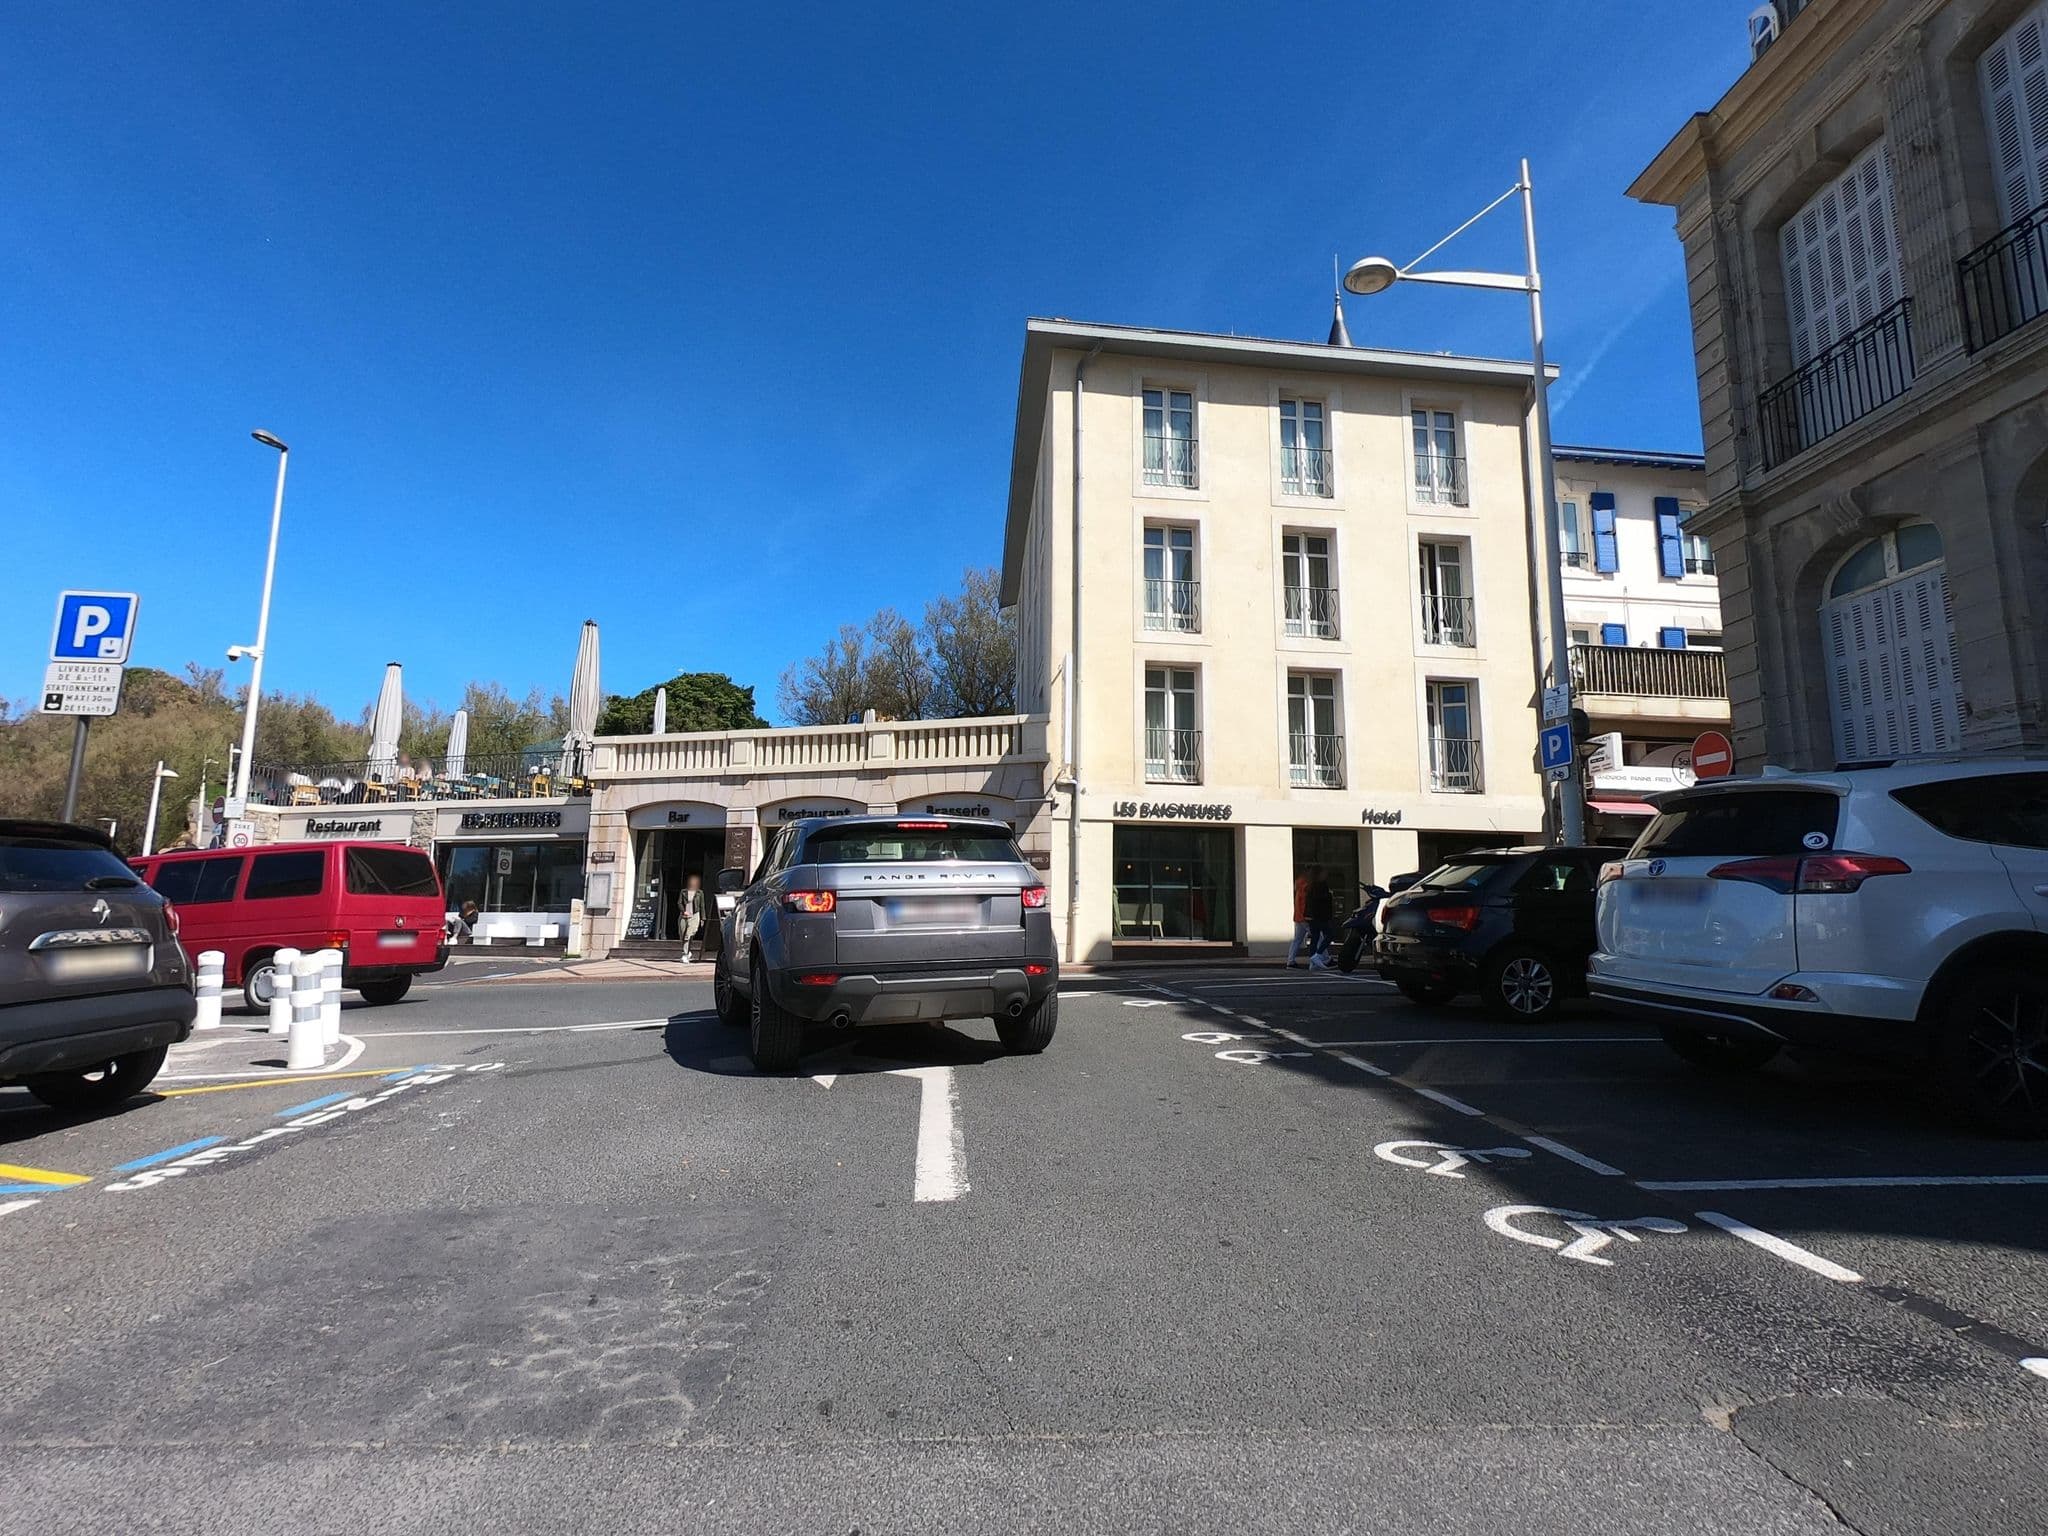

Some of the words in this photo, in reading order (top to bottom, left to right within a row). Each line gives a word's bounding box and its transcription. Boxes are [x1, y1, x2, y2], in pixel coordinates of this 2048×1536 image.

[73, 605, 111, 648] P
[58, 665, 111, 673] LIVRAISON
[46, 684, 116, 693] STATIONNEMENT
[64, 704, 75, 712] DE
[1548, 734, 1562, 760] P
[668, 810, 690, 823] Bar
[778, 807, 851, 821] Restaurant
[926, 804, 990, 816] Brasserie
[1113, 801, 1138, 817] LES
[1139, 802, 1233, 820] BAIGNEUSES
[306, 818, 383, 833] Restaurant
[863, 873, 926, 881] RANGE
